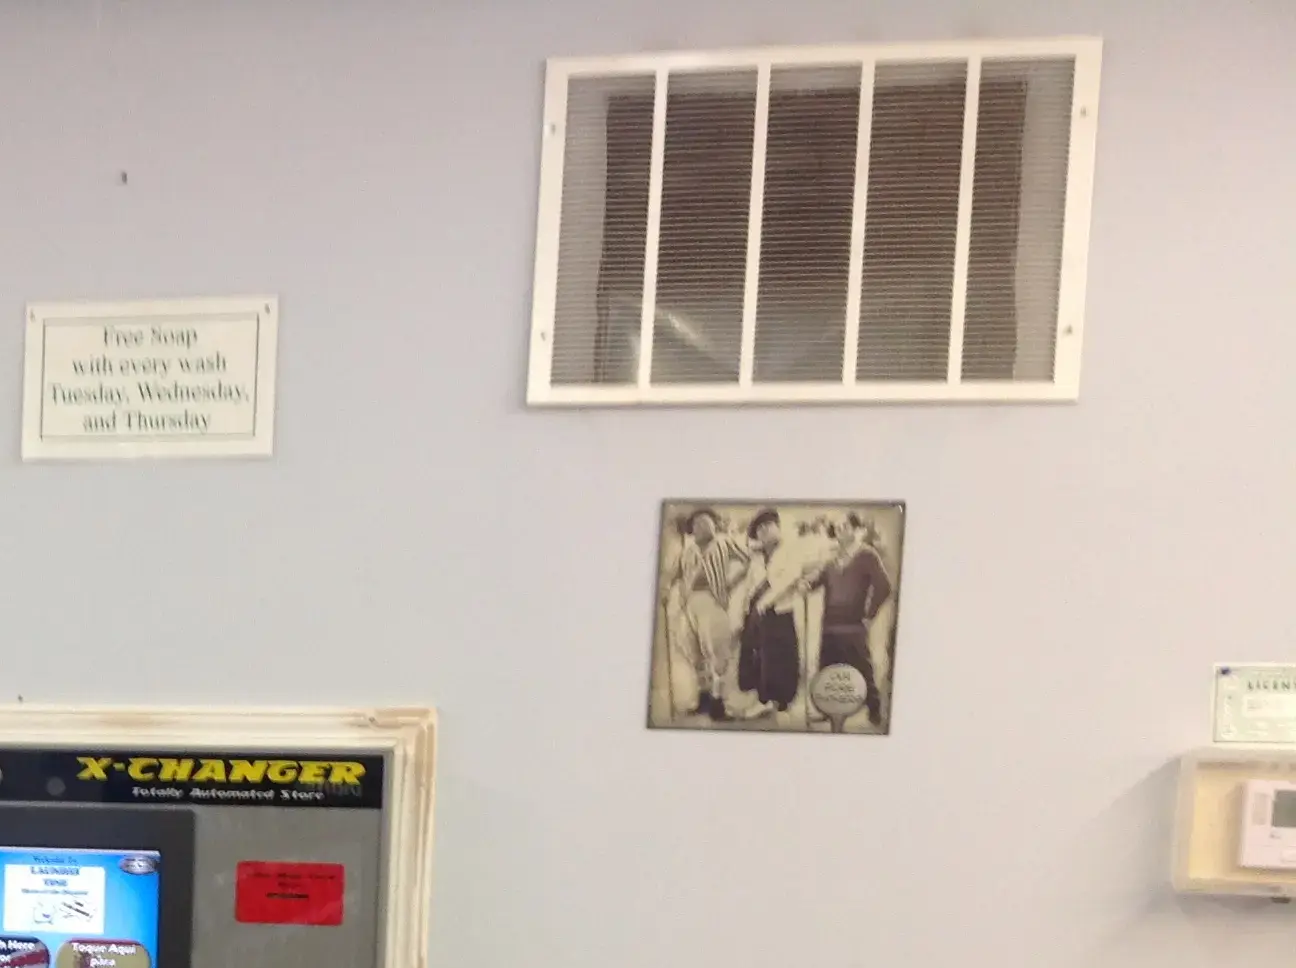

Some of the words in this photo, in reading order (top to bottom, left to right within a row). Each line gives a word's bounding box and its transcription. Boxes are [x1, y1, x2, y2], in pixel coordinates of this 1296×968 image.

[103, 325, 144, 348] Free
[150, 325, 198, 349] Soap
[71, 354, 114, 376] with
[119, 355, 171, 378] every
[178, 350, 227, 374] wash
[51, 382, 131, 407] Tuesday,
[137, 379, 250, 405] Wednesday,
[82, 410, 117, 432] and
[124, 409, 211, 435] Thursday
[1247, 679, 1296, 692] LICEN
[76, 756, 366, 785] X-CHANGER
[132, 785, 184, 799] Totally
[189, 787, 276, 800] Automated
[280, 789, 325, 801] Store
[7, 939, 35, 951] Here
[72, 942, 106, 955] Toque
